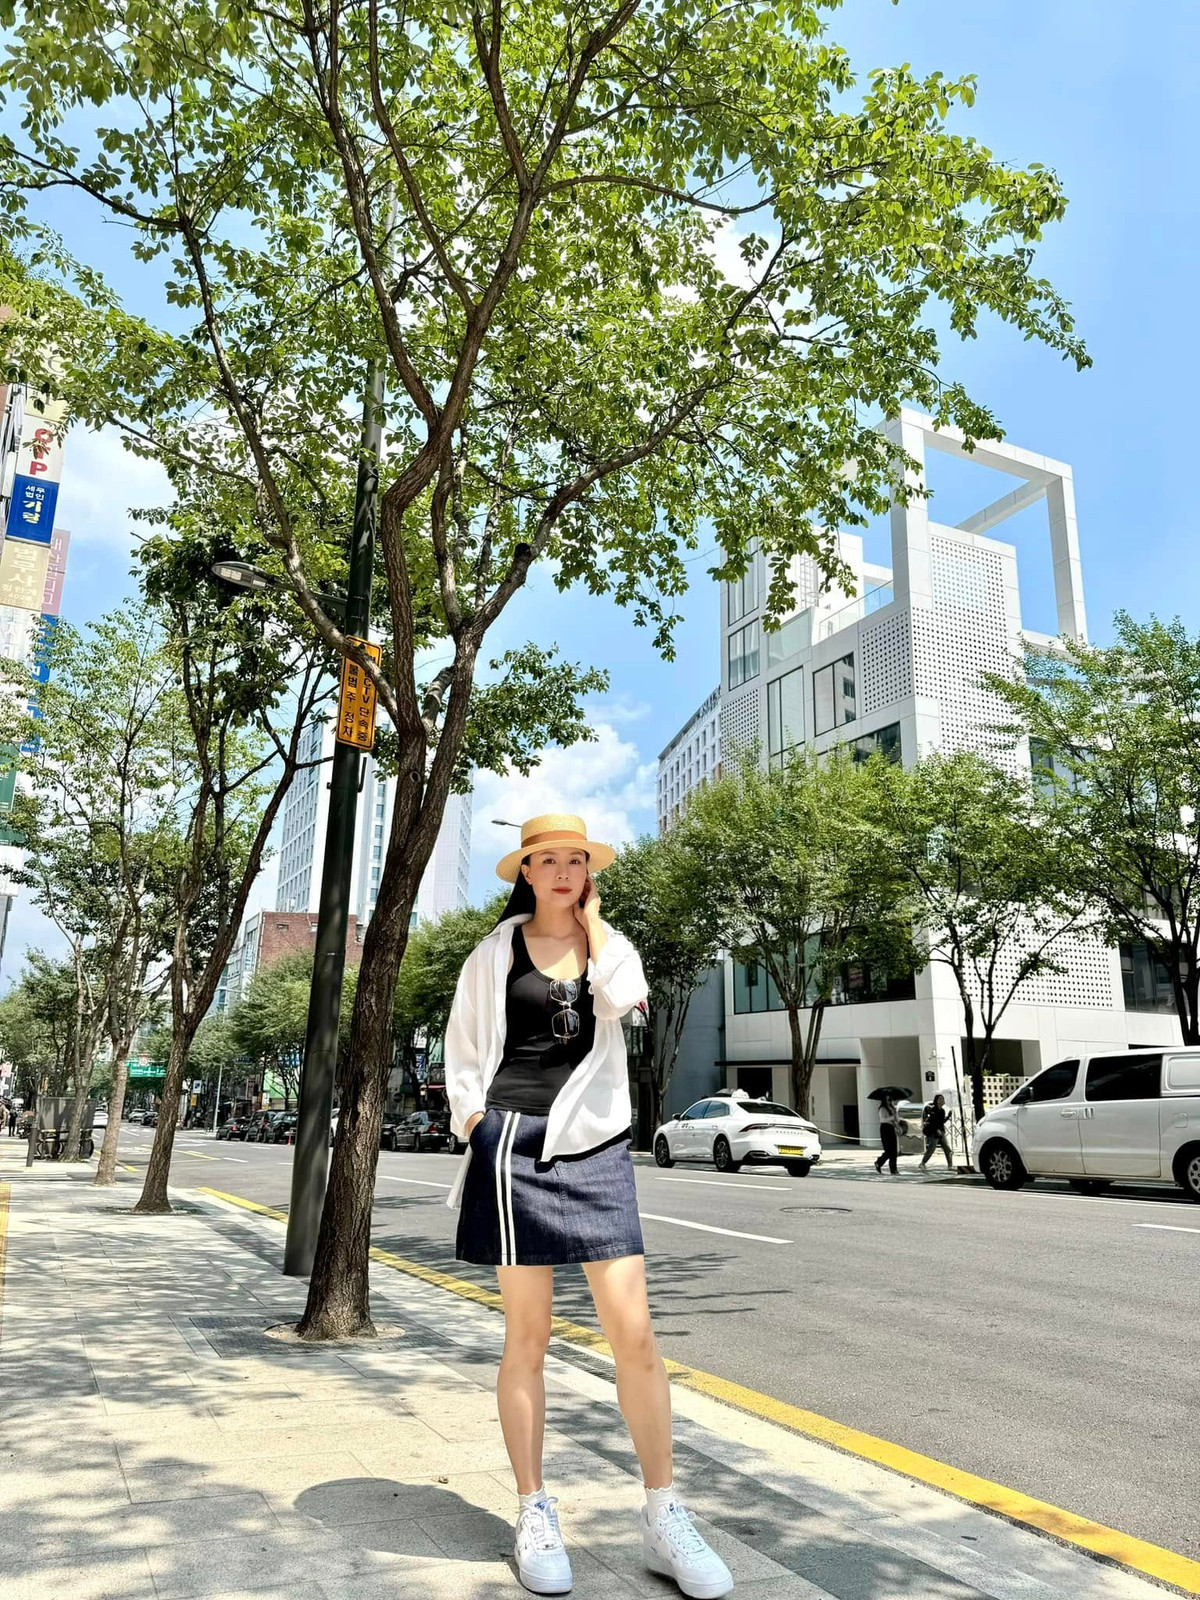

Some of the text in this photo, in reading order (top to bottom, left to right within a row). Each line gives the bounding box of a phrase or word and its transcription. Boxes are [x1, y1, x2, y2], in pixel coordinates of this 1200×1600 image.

[25, 484, 46, 494] 세무
[24, 491, 45, 501] 법인
[9, 547, 38, 587] 법무사
